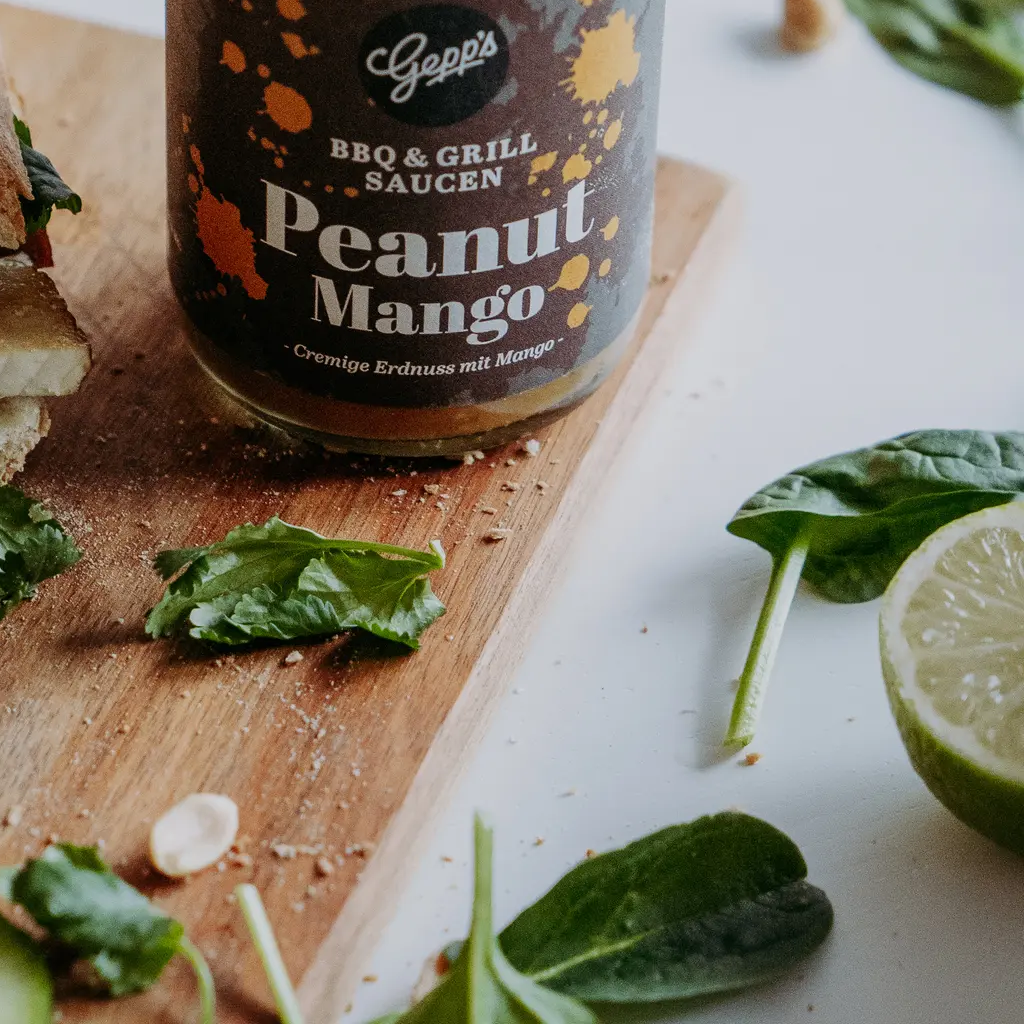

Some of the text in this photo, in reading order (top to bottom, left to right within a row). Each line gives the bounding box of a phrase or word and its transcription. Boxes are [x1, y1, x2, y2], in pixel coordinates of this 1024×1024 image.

[366, 29, 499, 104] Gepp's
[330, 132, 538, 171] BBQ & GRILL
[365, 166, 503, 194] SAUCEN
[260, 178, 595, 277] Peanut
[311, 275, 545, 346] Mango
[293, 343, 370, 374] Cremige
[373, 360, 456, 376] Erdnuss
[459, 356, 491, 374] mit
[495, 339, 555, 367] Mango
